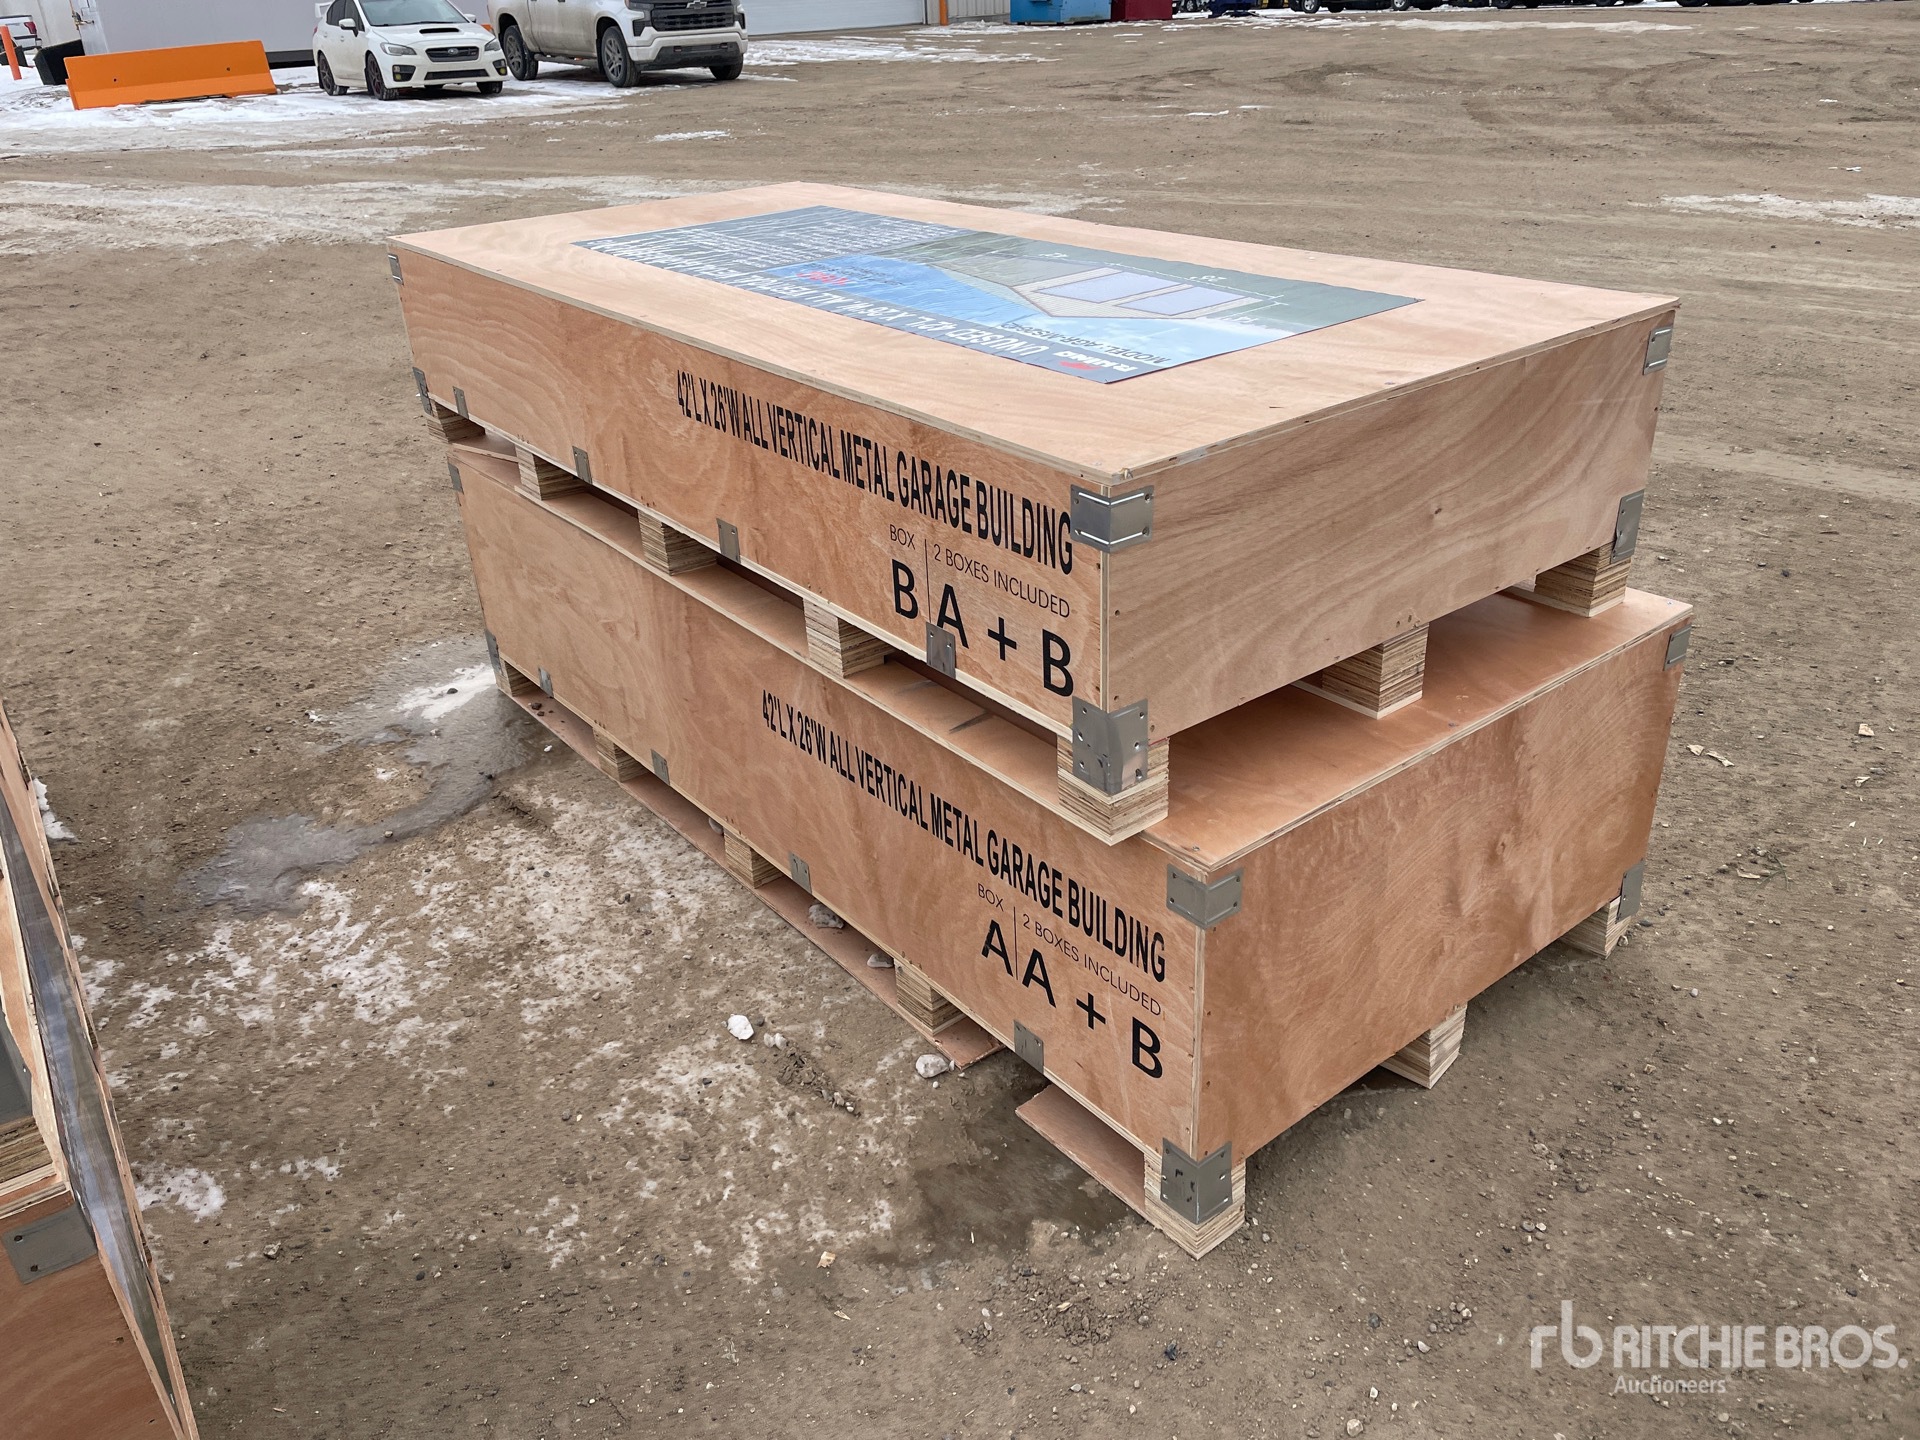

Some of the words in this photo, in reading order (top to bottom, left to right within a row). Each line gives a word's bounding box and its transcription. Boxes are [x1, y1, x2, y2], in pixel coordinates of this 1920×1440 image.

[797, 292, 857, 305] ALL
[876, 311, 919, 321] X
[938, 327, 1055, 355] UNUSED
[1050, 350, 1140, 372] RHINO
[1094, 345, 1172, 364] MODEL:
[698, 377, 712, 427] X
[742, 393, 768, 450] ALL
[766, 402, 840, 479] VERTICAL
[840, 429, 894, 502] METAL
[896, 451, 972, 534] GARAGE
[976, 480, 1073, 575] BUILDING
[889, 524, 915, 550] BOX
[892, 559, 919, 620] B
[933, 544, 941, 562] 2
[946, 549, 989, 583] BOXES
[994, 570, 1070, 619] INCLUDED
[936, 583, 969, 650] A
[1042, 629, 1074, 697] B
[786, 704, 797, 746] X
[830, 731, 855, 783] ALL
[855, 746, 928, 831] VERTICAL
[930, 793, 984, 867] METAL
[987, 829, 1063, 918] GARAGE
[1068, 878, 1166, 982] BUILDING
[978, 883, 1004, 912] BOX
[981, 919, 1013, 978] A
[1023, 914, 1031, 931] 2
[1035, 922, 1079, 962] BOXES
[1084, 952, 1161, 1017] INCLUDED
[1022, 948, 1057, 1008] A
[1132, 1017, 1163, 1079] B
